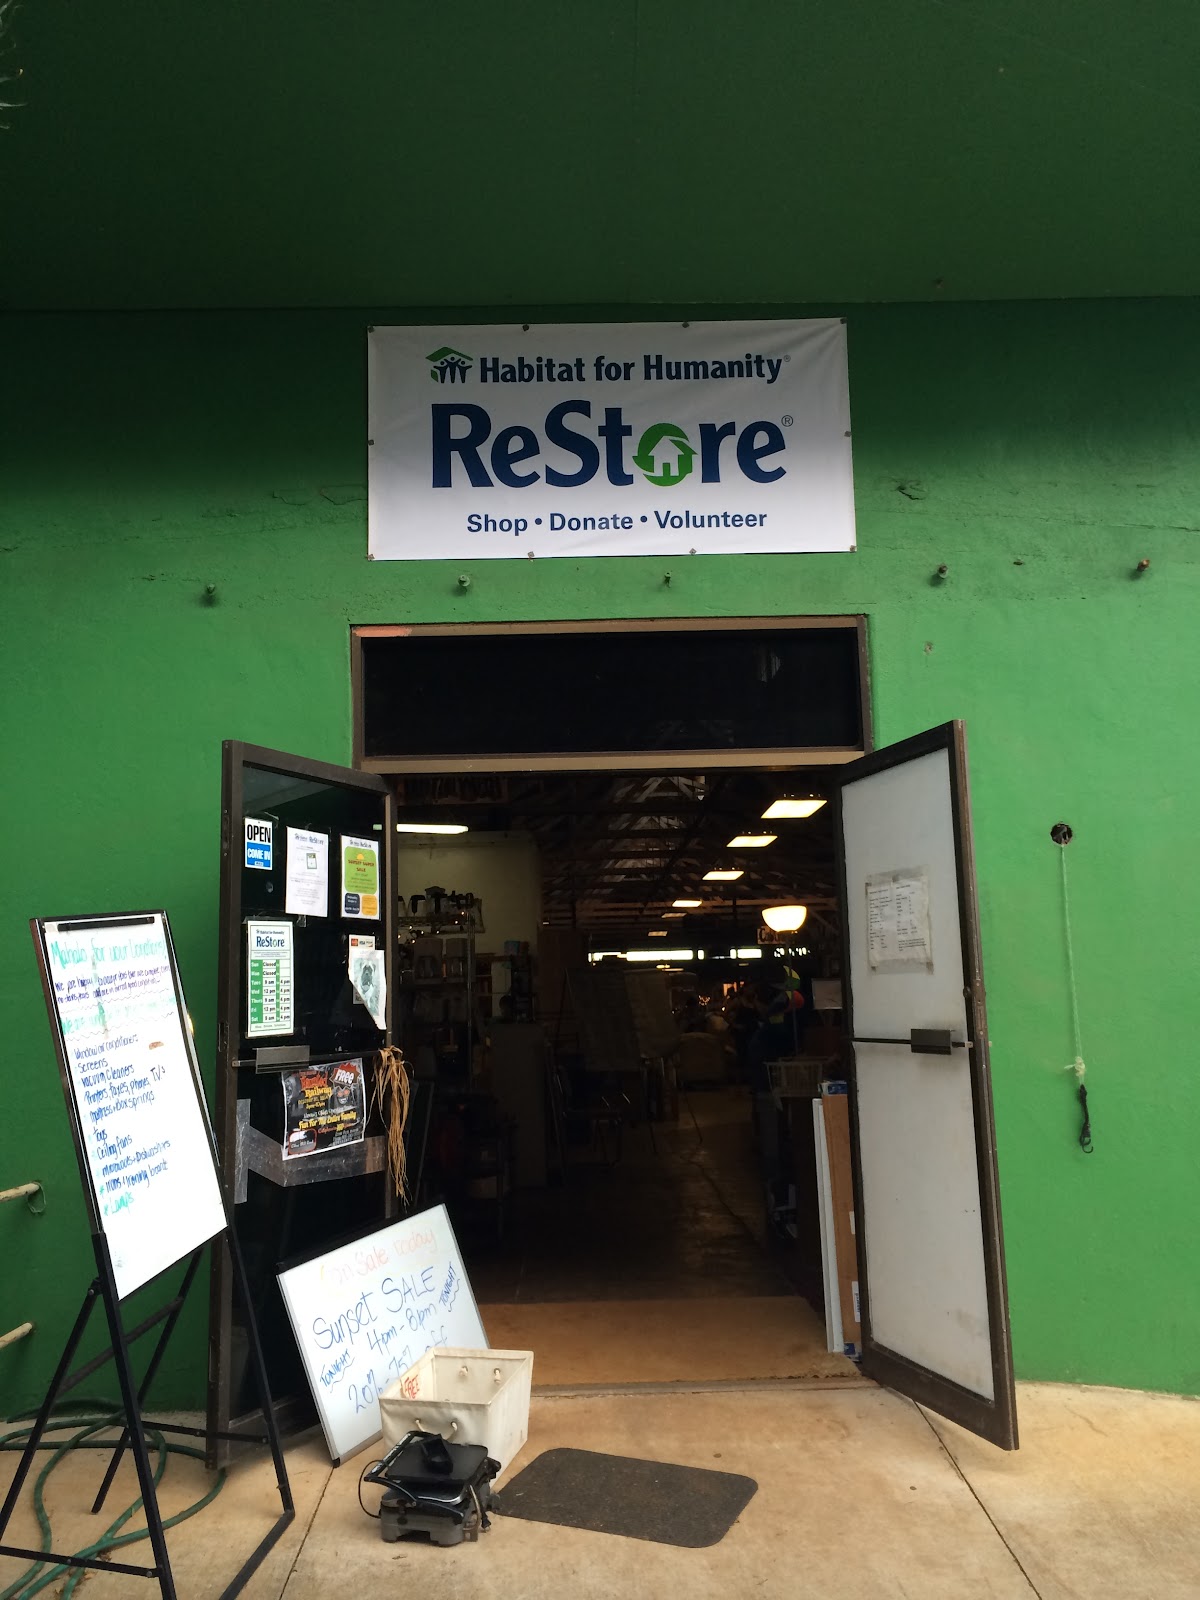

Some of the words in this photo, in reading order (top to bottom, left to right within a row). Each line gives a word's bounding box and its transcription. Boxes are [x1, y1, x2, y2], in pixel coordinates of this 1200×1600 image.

[480, 355, 586, 384] Habitat
[594, 354, 635, 382] for
[467, 512, 528, 538] Shop
[549, 511, 634, 533] Donate
[654, 509, 768, 530] Volunteer
[246, 823, 271, 844] OPEN
[247, 847, 264, 860] COME
[263, 851, 271, 861] IN
[50, 940, 87, 969] Mahalo
[91, 937, 105, 962] for
[256, 935, 285, 948] ReStore
[78, 1057, 108, 1074] Screens
[438, 1261, 457, 1307] TONIGHT
[312, 1290, 378, 1350] Sunset
[319, 1348, 352, 1388] TONIGHT
